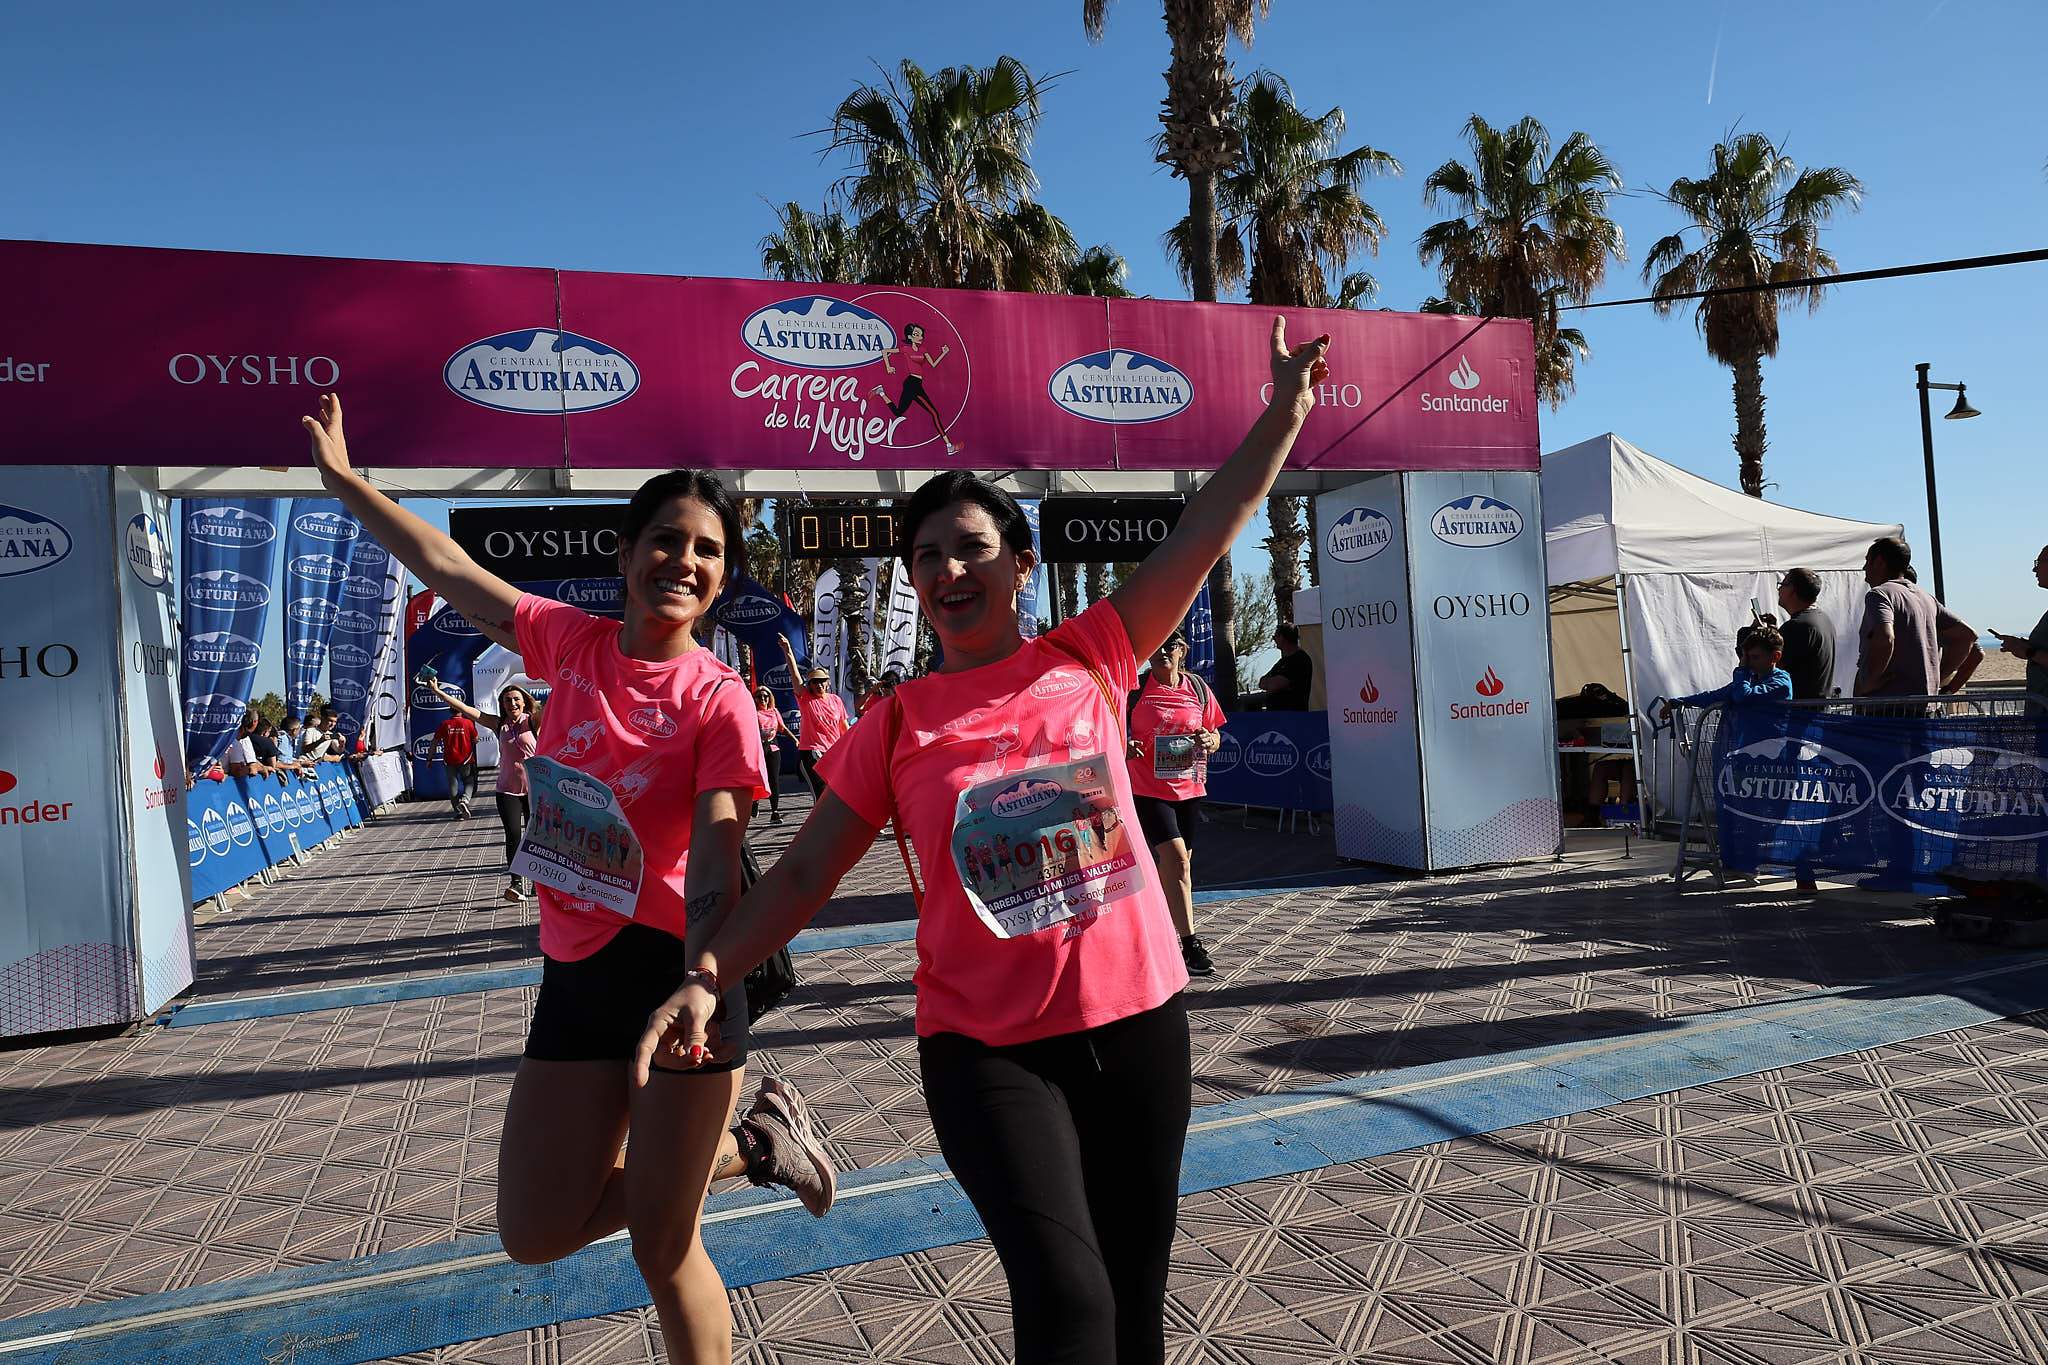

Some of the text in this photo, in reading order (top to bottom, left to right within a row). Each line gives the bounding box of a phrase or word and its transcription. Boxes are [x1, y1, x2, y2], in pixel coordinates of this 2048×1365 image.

[755, 319, 885, 351] ASTURIANA
[778, 319, 880, 330] CENTRAL LECHERA
[168, 353, 341, 387] OYSHO
[489, 356, 552, 367] CENTRAL
[460, 358, 627, 392] ASTURIANA
[730, 360, 861, 401] Carrera
[1131, 375, 1178, 383] LECHERA
[1061, 374, 1184, 405] ASTURIANA
[1420, 392, 1509, 413] Santander
[764, 399, 907, 461] de la Mujer
[191, 518, 268, 540] ASTURIANA
[299, 518, 355, 537] ASTURIANA
[1065, 519, 1168, 542] OYSHO
[1438, 515, 1517, 535] ASTURIANA
[485, 529, 619, 558] OYSHO
[1331, 528, 1388, 553] ASTURIANA
[1331, 600, 1398, 630] OYSHO
[1433, 592, 1531, 619] OYSHO
[133, 641, 176, 678] OYSHO
[1343, 708, 1398, 724] Santander
[1450, 698, 1530, 720] Santander
[1247, 746, 1293, 766] ASTURIANA
[561, 783, 606, 807] ASTURIANA
[1723, 762, 1860, 805] ASTURIANA
[997, 788, 1058, 815] ASTURIANA
[563, 820, 602, 853] 016
[1014, 828, 1077, 867] 016
[528, 844, 557, 861] CARRERA
[557, 855, 567, 865] DE
[599, 872, 633, 890] VALENCIA
[528, 860, 567, 883] OYSHO
[1038, 863, 1066, 881] 4378
[586, 882, 625, 904] Santander
[987, 858, 1128, 912] ARRERA DE LA MUJER VALENCIA
[1080, 880, 1129, 901] Santander
